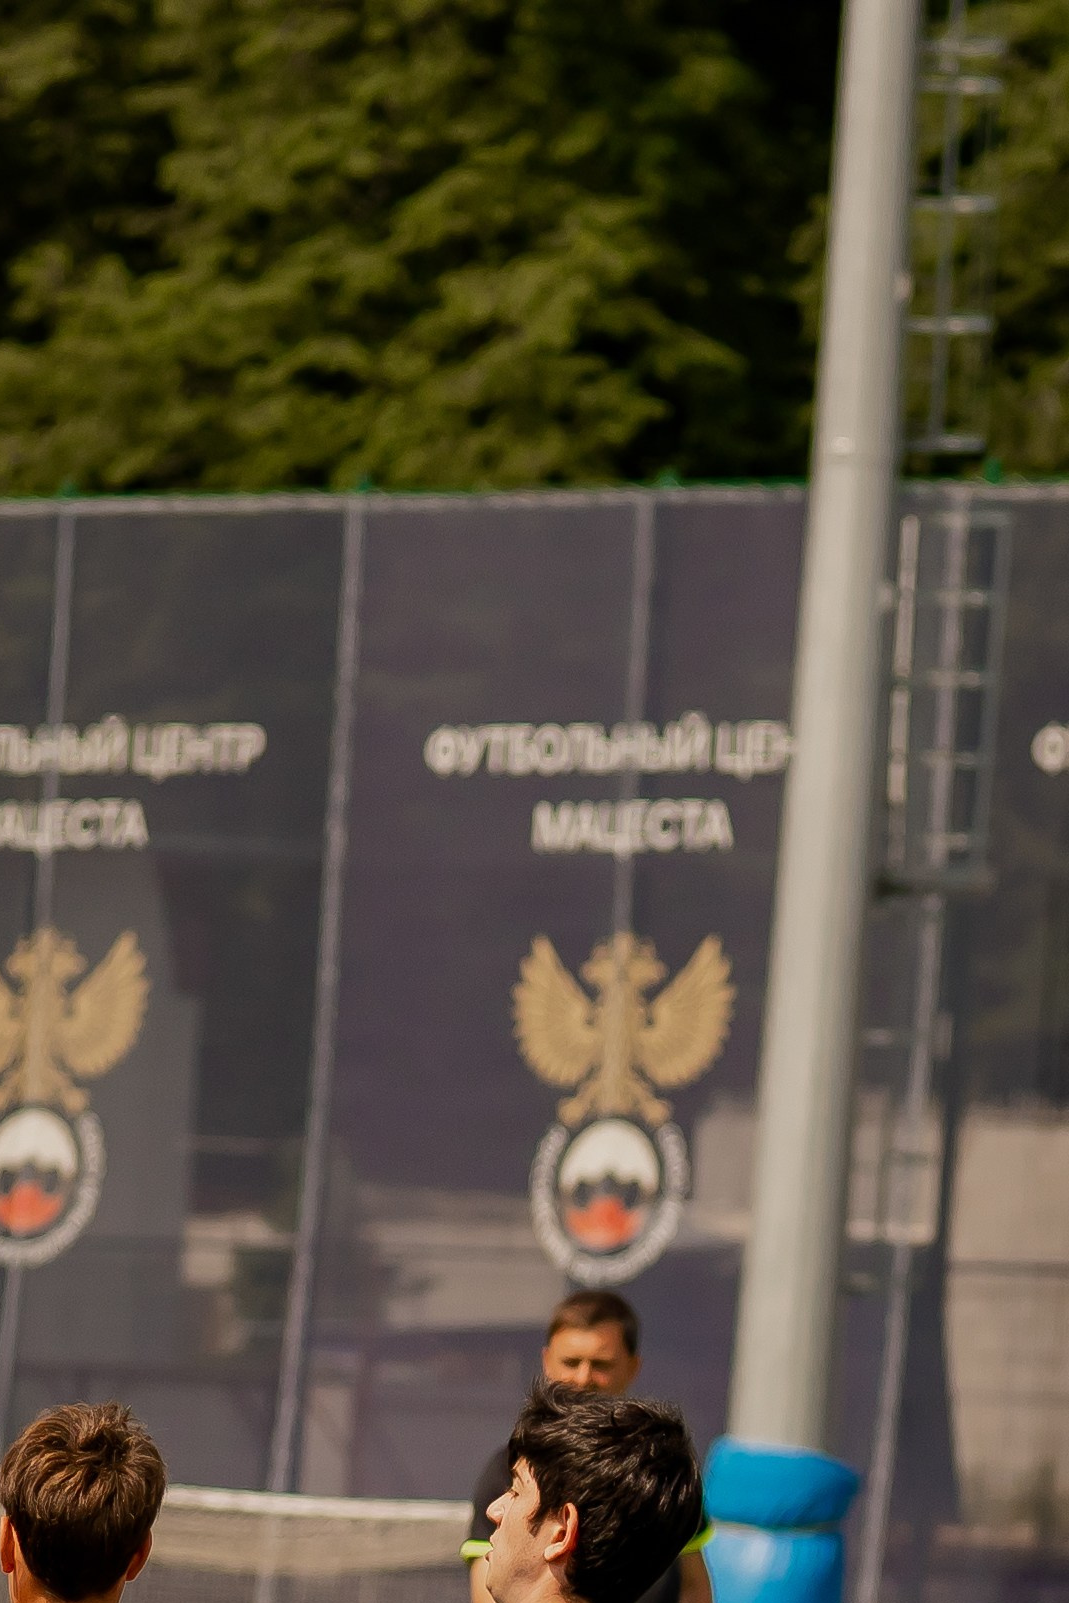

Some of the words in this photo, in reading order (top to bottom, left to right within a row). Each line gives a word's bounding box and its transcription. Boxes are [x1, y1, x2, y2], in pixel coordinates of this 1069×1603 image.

[131, 722, 267, 782] ЦЕНТР
[425, 710, 713, 778] ФУТБОЛЬНЫЙ
[532, 799, 732, 860] МАЦЕСТА
